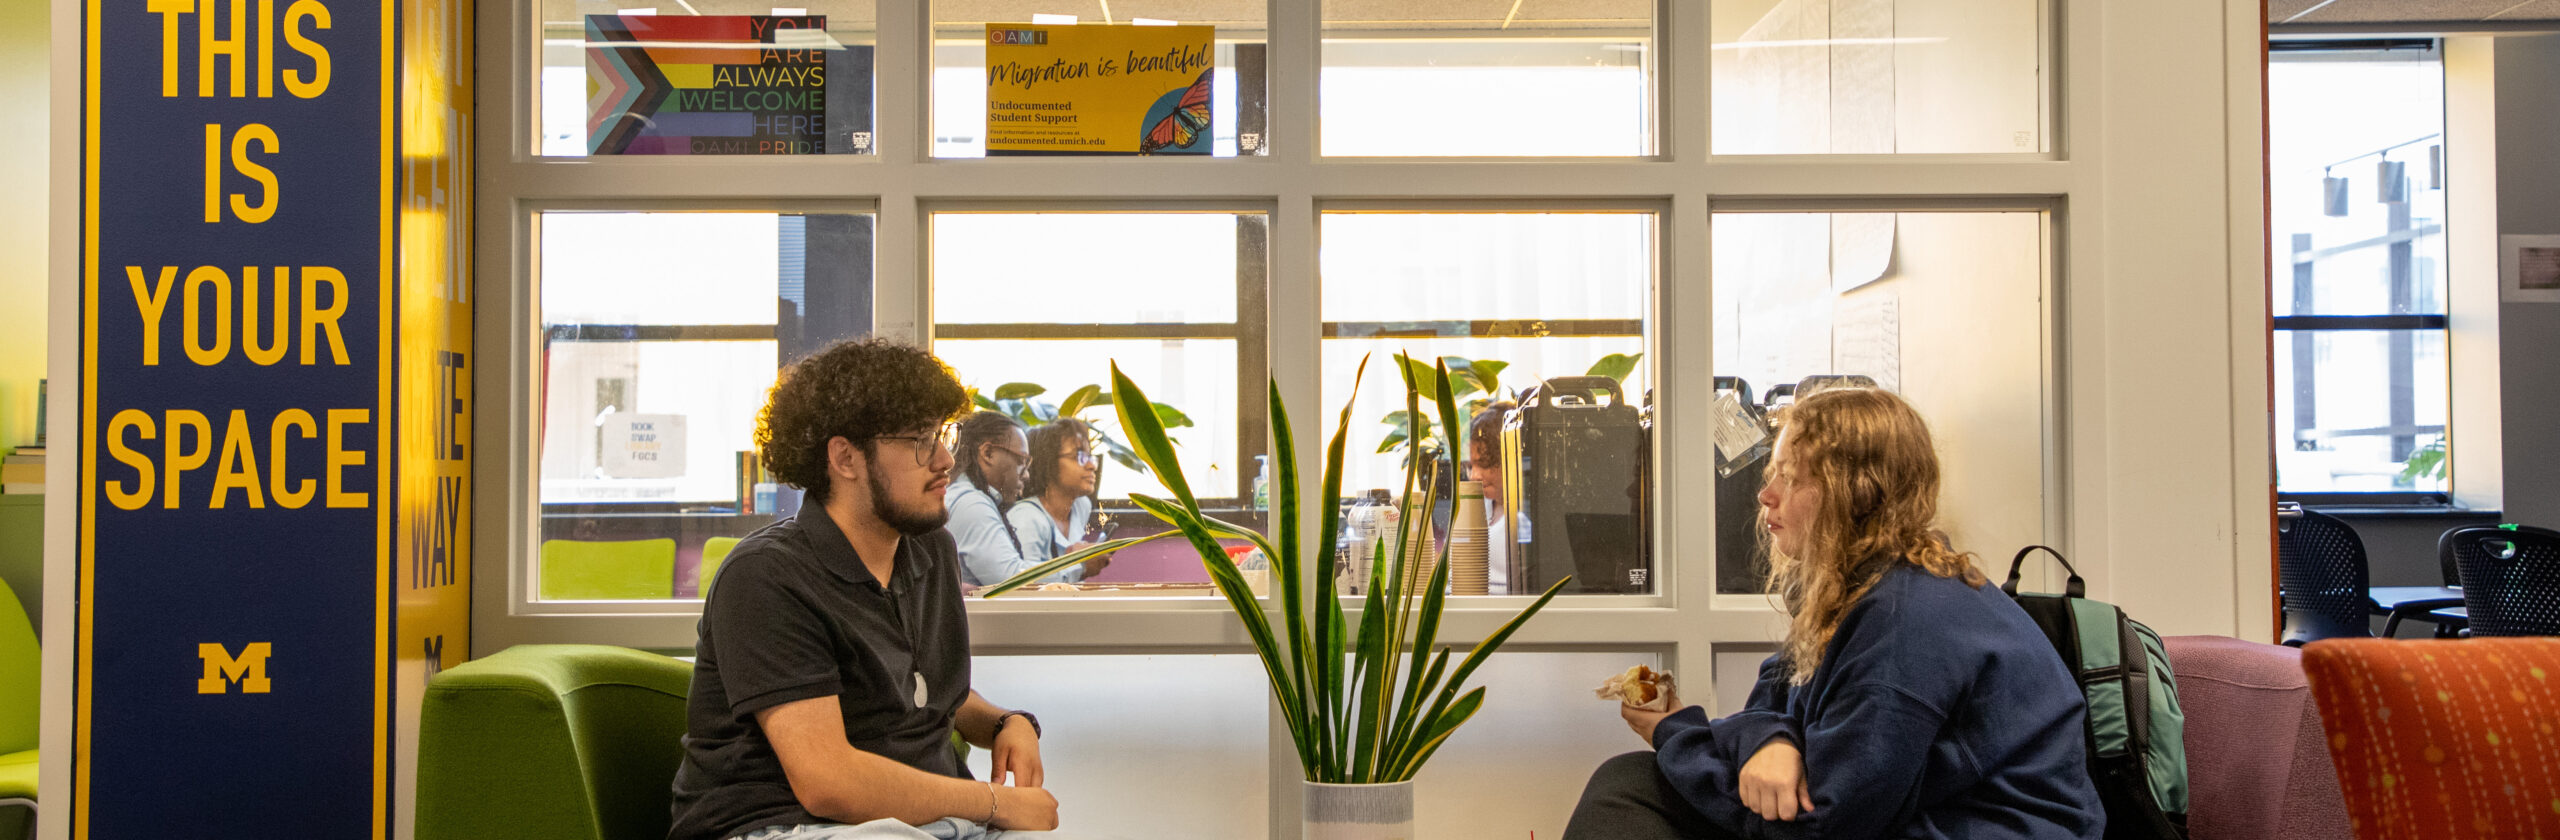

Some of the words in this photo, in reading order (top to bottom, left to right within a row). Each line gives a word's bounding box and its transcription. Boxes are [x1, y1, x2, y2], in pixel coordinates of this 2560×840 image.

[991, 30, 1045, 44] OAMI
[147, 0, 332, 99] THIS
[762, 48, 824, 63] ARE
[714, 66, 824, 87] ALWAYS
[989, 57, 1090, 90] Migration
[1097, 56, 1119, 77] is
[1126, 42, 1210, 75] beautiful
[681, 90, 824, 111] WELCOME
[991, 100, 1072, 111] Undocumented
[753, 115, 824, 136] HERE
[990, 112, 1032, 123] Student
[1034, 113, 1078, 125] Support
[691, 140, 749, 155] OAMI
[759, 140, 824, 155] PRIDE
[990, 136, 1106, 146] undocumented.umich.edu
[205, 123, 280, 224] IS
[126, 266, 351, 367] YOUR
[105, 408, 370, 511] SPACE
[411, 475, 461, 590] WAY
[198, 642, 272, 695] M
